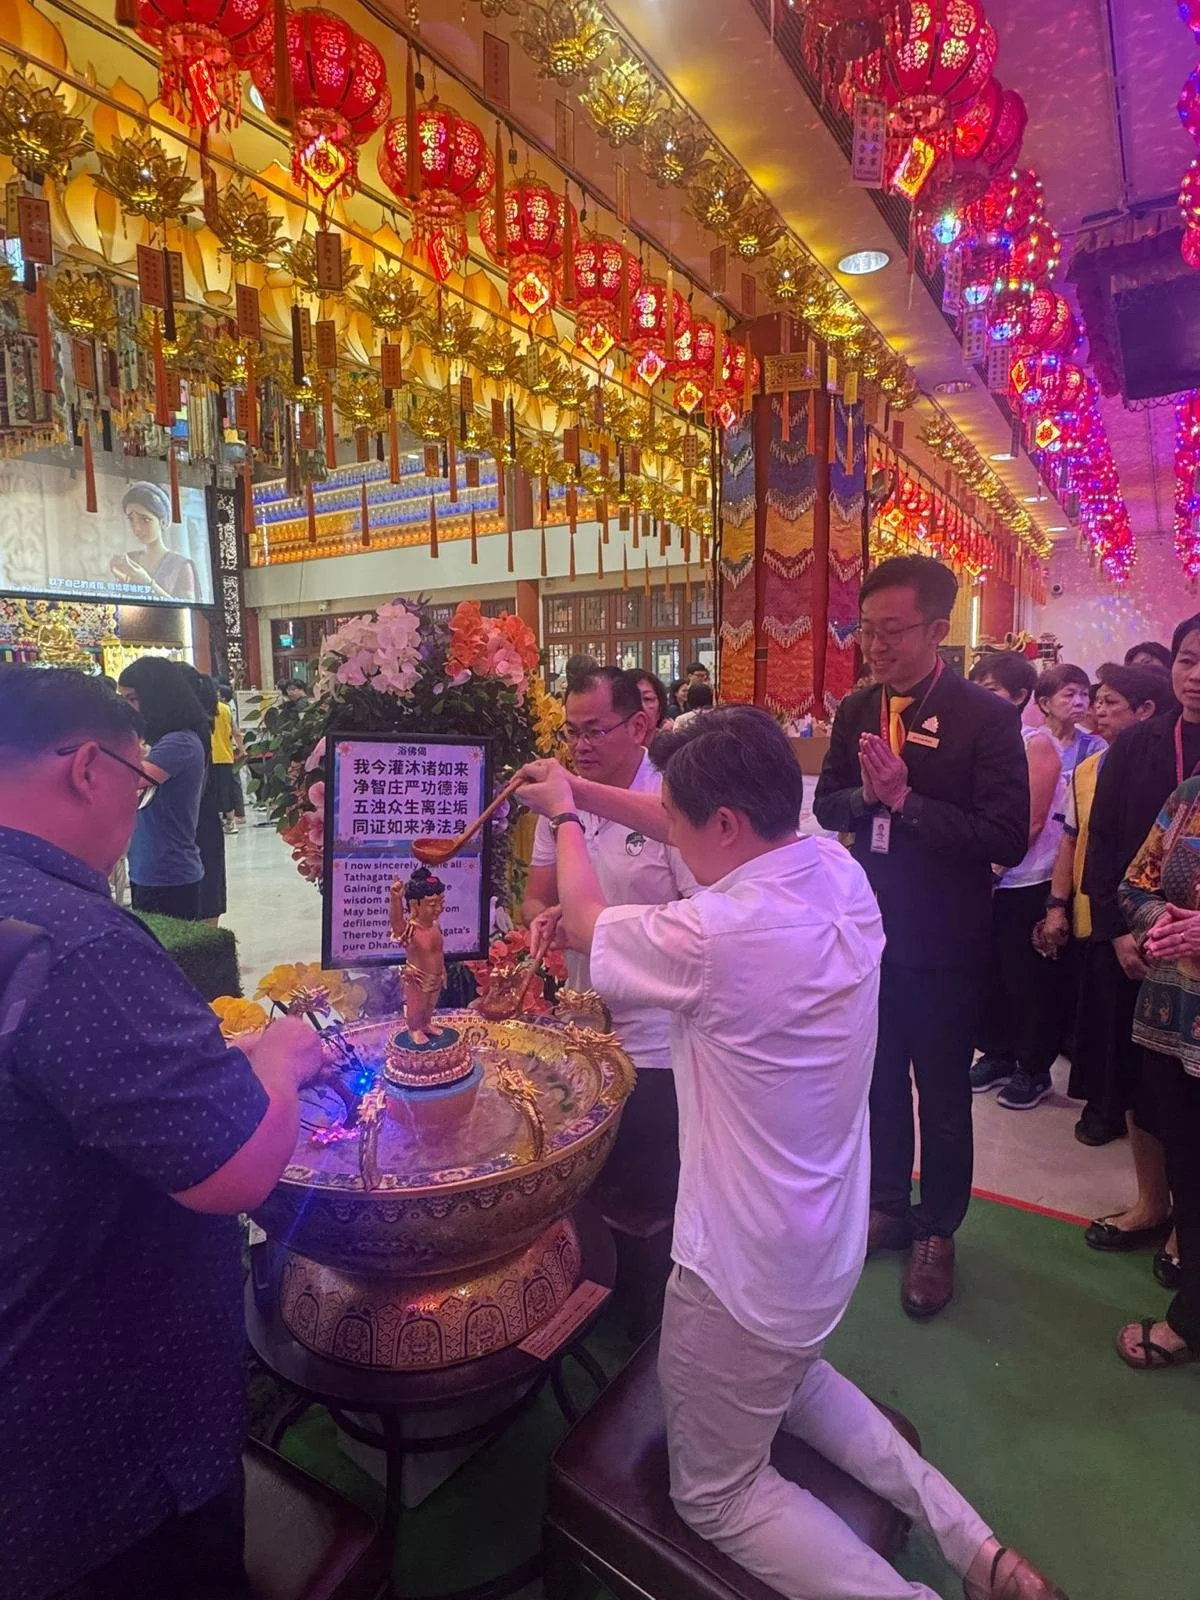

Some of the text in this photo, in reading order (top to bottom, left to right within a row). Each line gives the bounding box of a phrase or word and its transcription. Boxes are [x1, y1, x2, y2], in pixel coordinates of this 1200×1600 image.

[397, 745, 427, 756] 浴佛偈
[353, 758, 469, 777] 我今灌沐诸如来
[353, 779, 469, 796] 净智庄严功德海
[353, 799, 468, 815] 五浊众生离尘垢
[352, 819, 467, 835] 同证如来净法身
[374, 861, 418, 871] sincerely
[451, 860, 462, 868] all
[344, 873, 393, 883] Tathagata
[344, 884, 382, 894] Gaining
[343, 896, 382, 904] wisdom
[343, 908, 364, 917] May
[367, 907, 389, 915] bein
[343, 919, 391, 928] defileme
[342, 930, 384, 940] Thereby
[343, 943, 366, 952] pure
